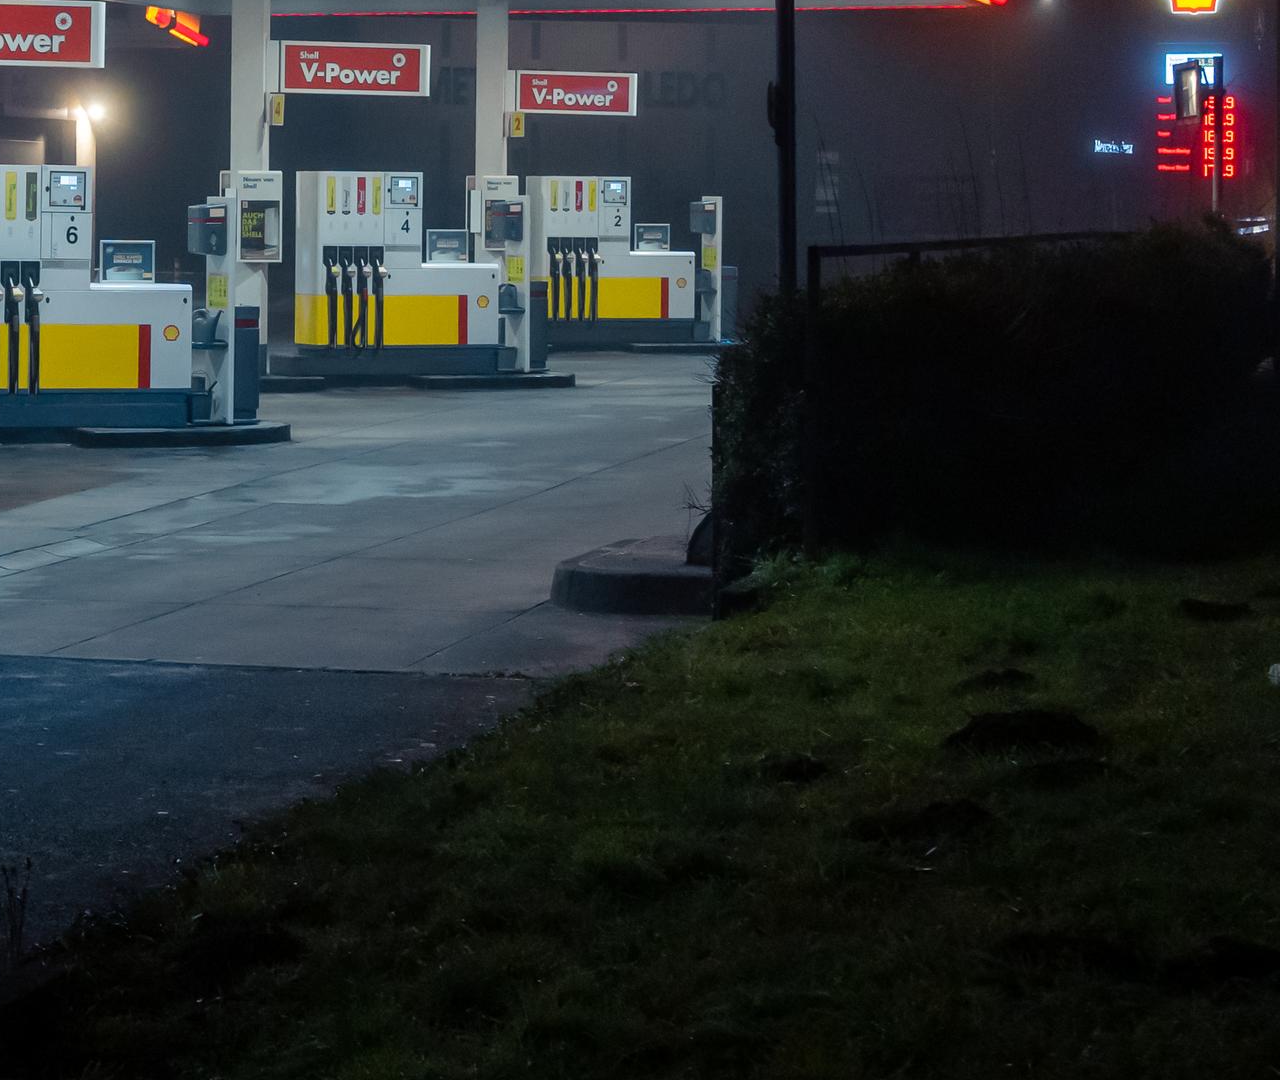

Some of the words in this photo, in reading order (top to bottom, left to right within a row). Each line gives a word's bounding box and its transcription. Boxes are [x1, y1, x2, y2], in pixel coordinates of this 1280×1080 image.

[300, 51, 319, 60] Shell
[300, 62, 400, 85] V-Power
[532, 88, 613, 107] V-Power
[515, 118, 521, 130] 2
[401, 219, 410, 233] 4
[614, 215, 622, 227] 2
[66, 226, 78, 244] 6
